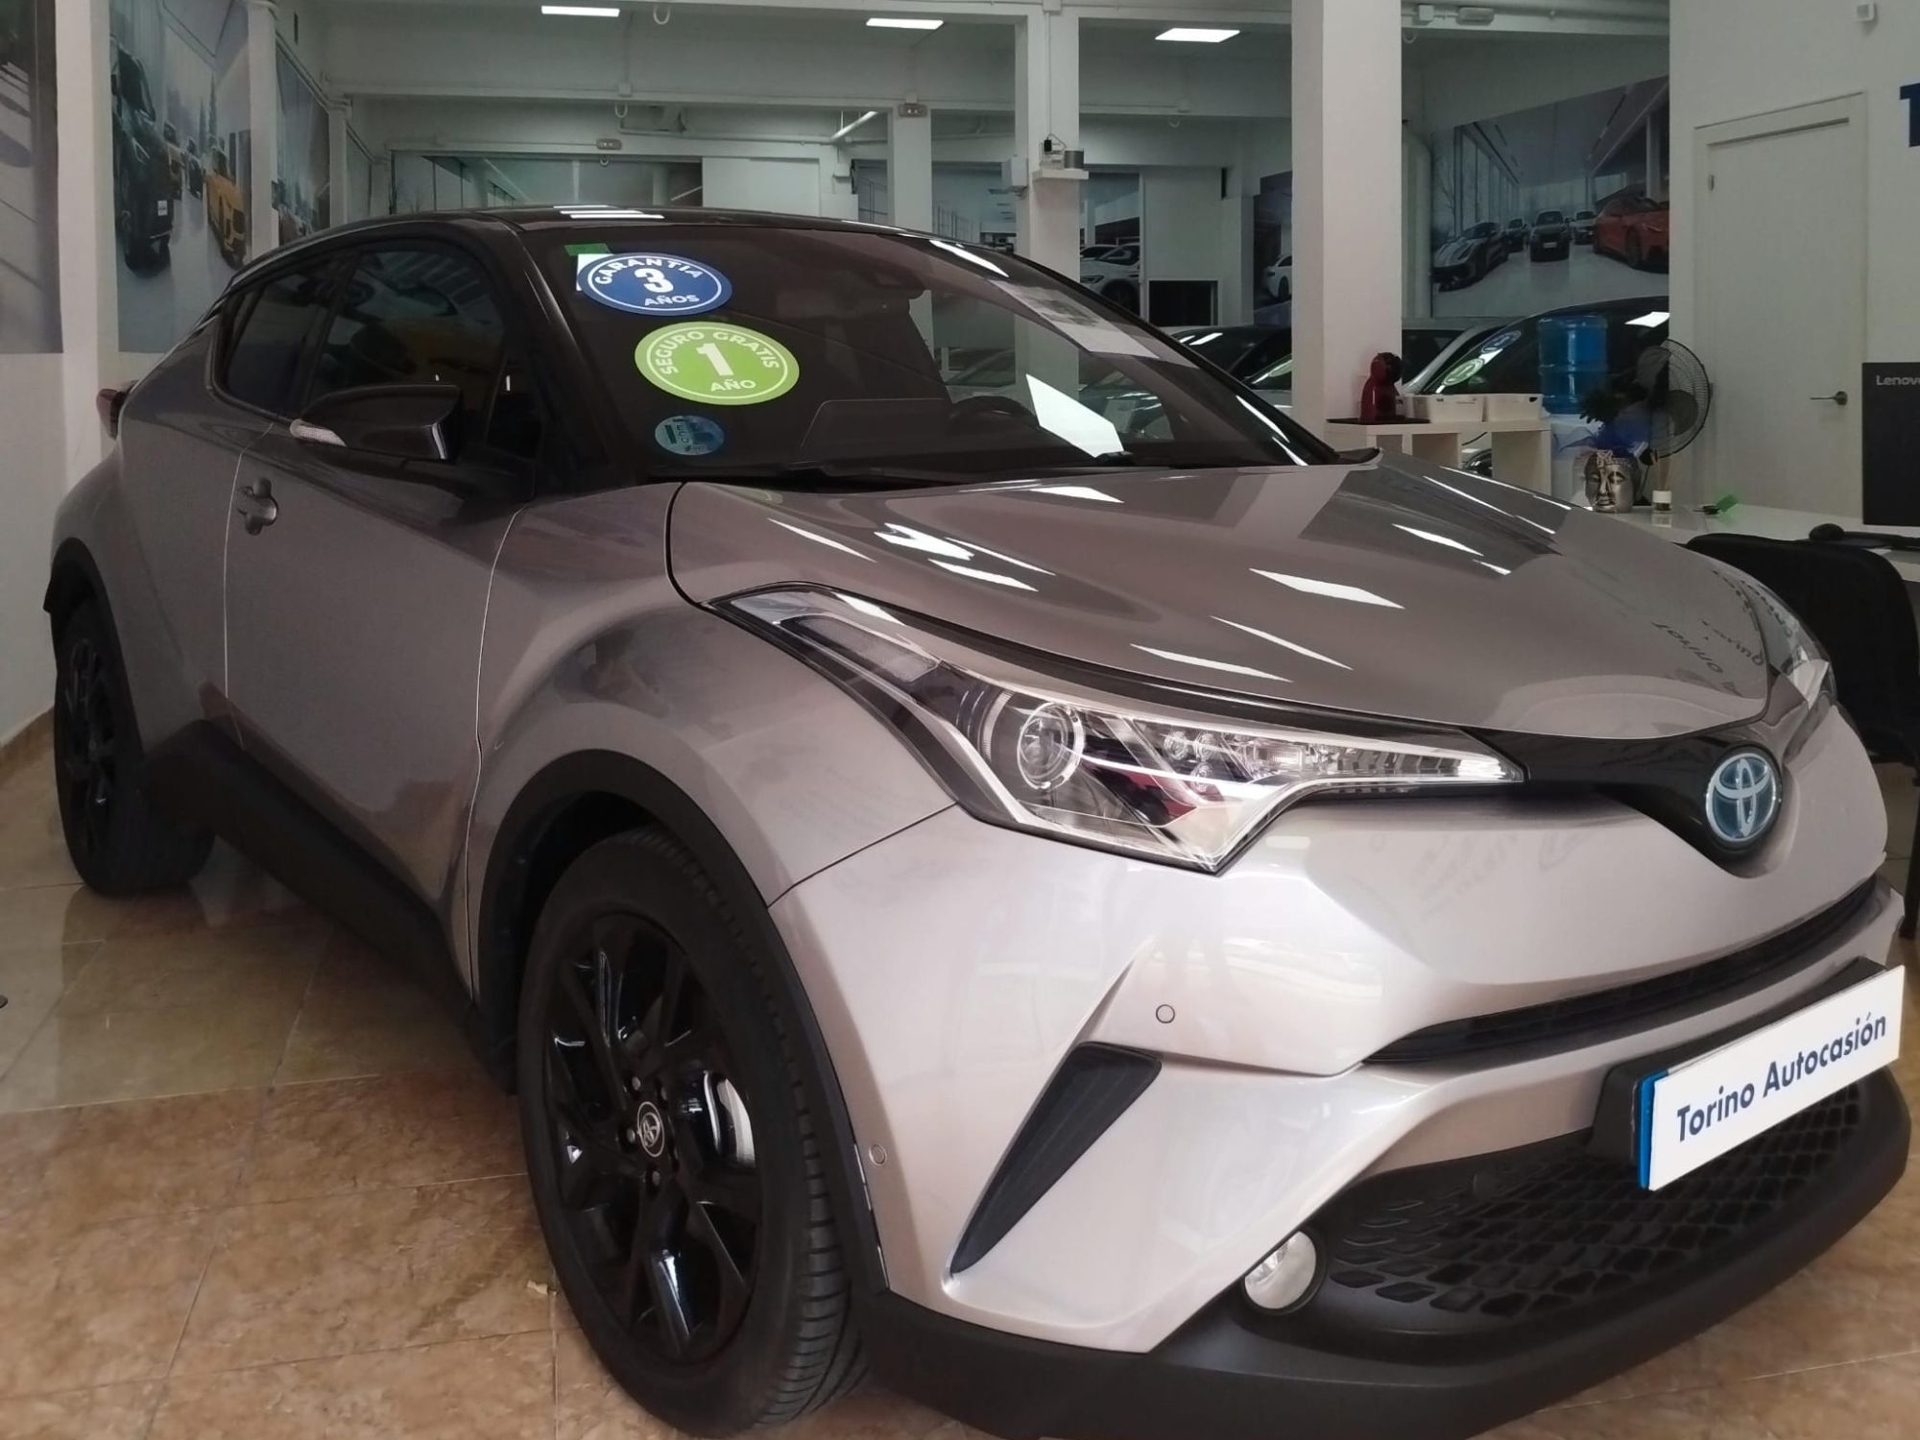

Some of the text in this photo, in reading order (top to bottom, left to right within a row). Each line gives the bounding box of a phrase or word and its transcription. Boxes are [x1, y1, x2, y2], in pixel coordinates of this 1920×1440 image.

[634, 268, 674, 293] 3
[644, 294, 700, 306] AÑOS
[655, 331, 780, 375] SEGURO GRATIS
[696, 342, 734, 376] 1
[711, 378, 757, 392] AÑO
[1876, 375, 1920, 386] Lenov
[1677, 1012, 1886, 1142] Torino Autocasión
